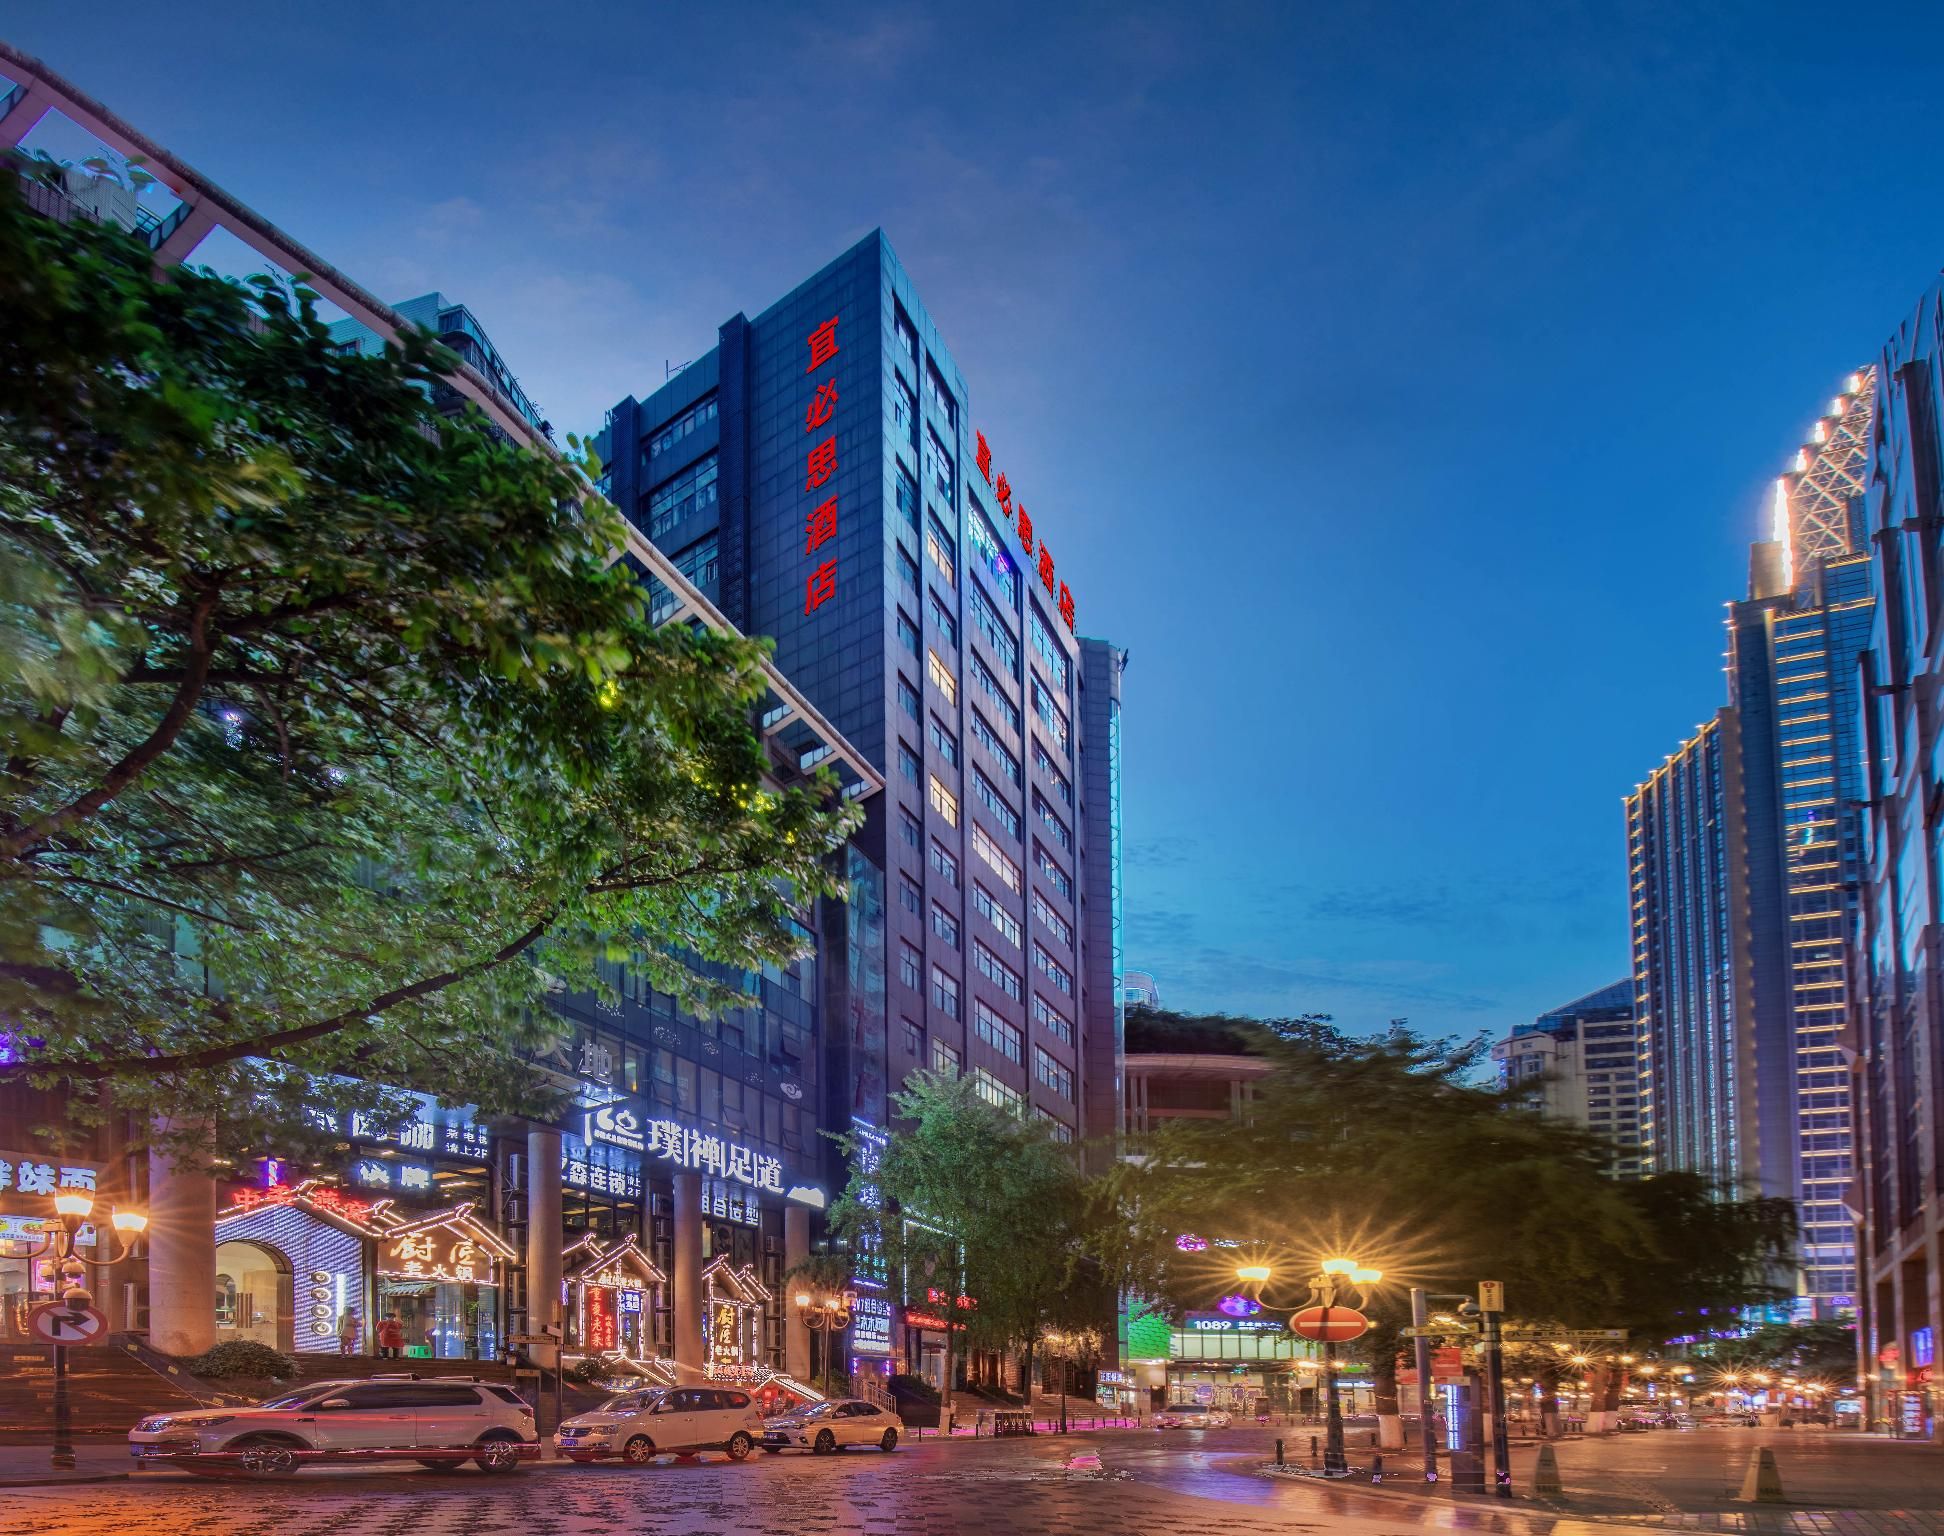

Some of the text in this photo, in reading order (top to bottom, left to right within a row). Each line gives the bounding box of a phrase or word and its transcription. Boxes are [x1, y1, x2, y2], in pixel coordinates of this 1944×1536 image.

[805, 315, 840, 617] 宜必思酒店
[976, 428, 1075, 635] 宜必思酒店
[404, 1261, 474, 1280] 老火锅
[1194, 1320, 1231, 1330] 1089
